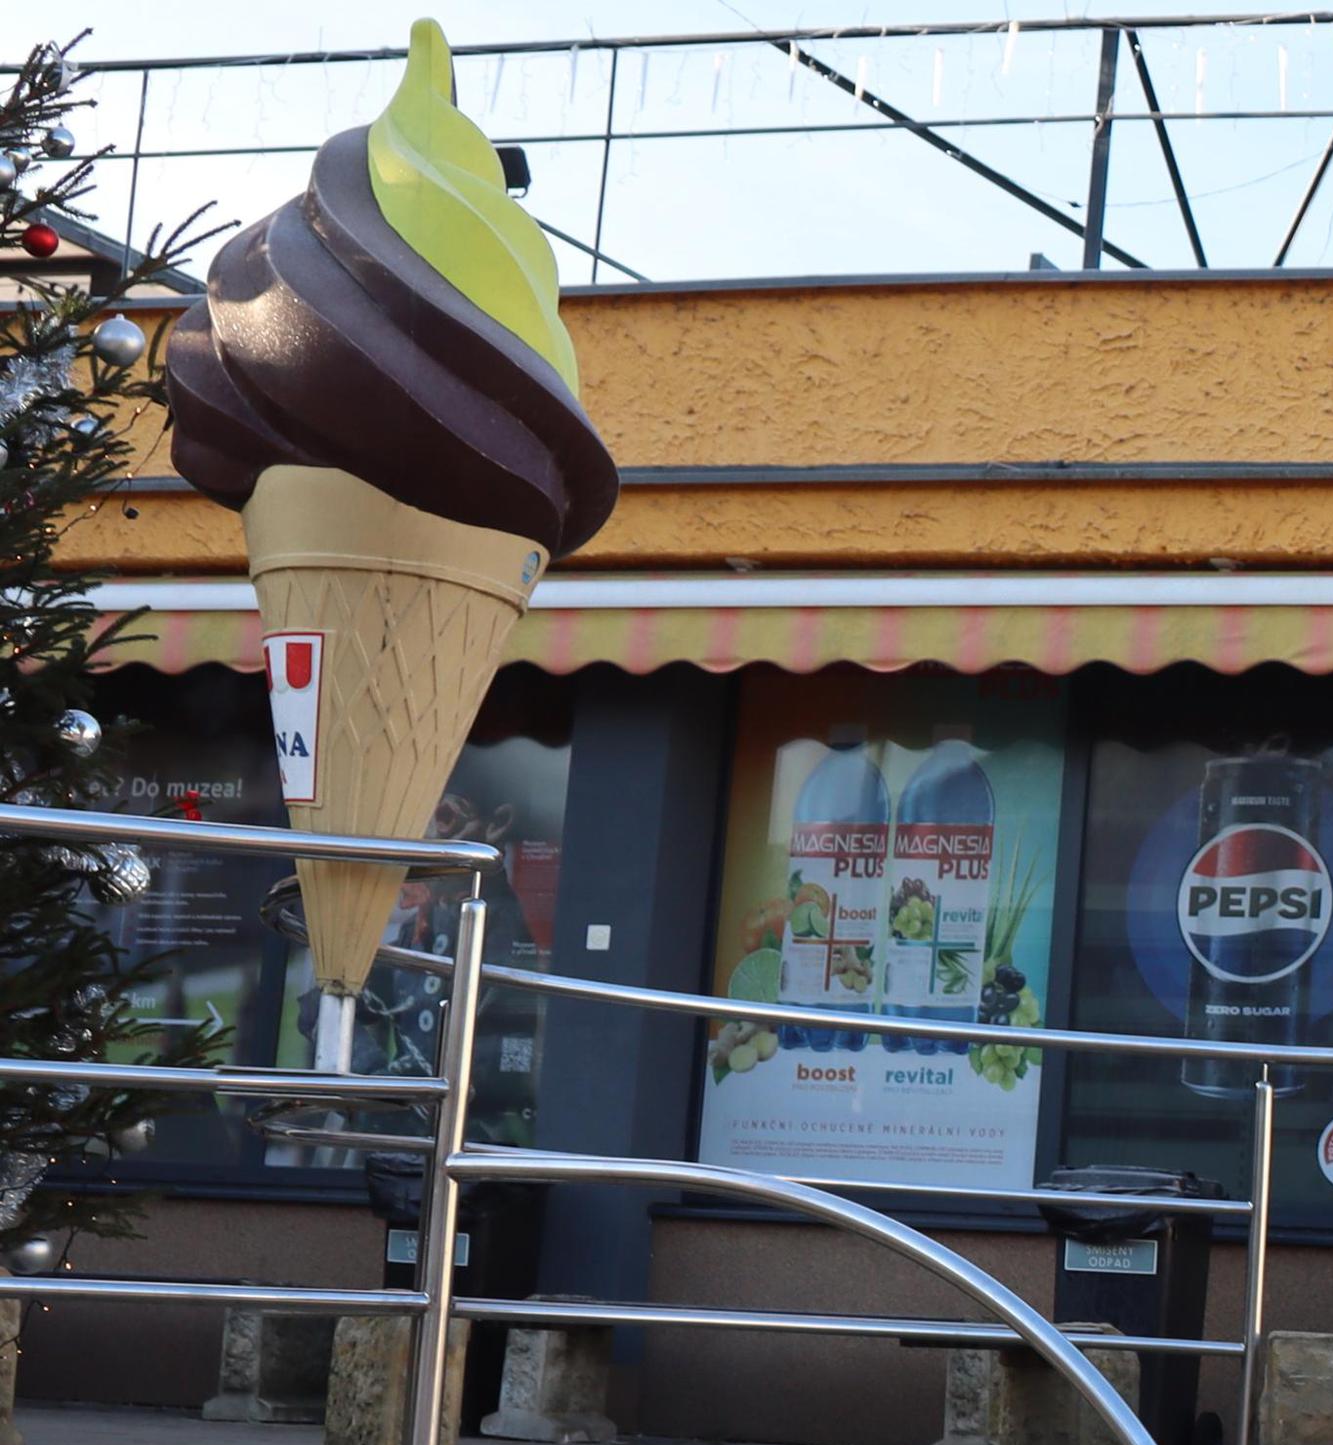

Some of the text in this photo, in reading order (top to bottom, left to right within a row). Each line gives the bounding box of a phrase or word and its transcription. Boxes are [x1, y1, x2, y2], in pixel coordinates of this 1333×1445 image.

[131, 777, 160, 797] Do
[166, 778, 243, 798] muzea!
[792, 833, 886, 853] MAGNESIA
[895, 834, 990, 855] MAGNESIA
[834, 857, 884, 878] PLUS
[938, 859, 989, 880] PLUS
[1188, 886, 1322, 919] PEPSI
[130, 992, 156, 1009] km
[1205, 1004, 1290, 1017] ZERO SUGAR
[797, 1064, 856, 1082] boost
[885, 1066, 953, 1085] revital
[1088, 1256, 1131, 1269] ODPAD
